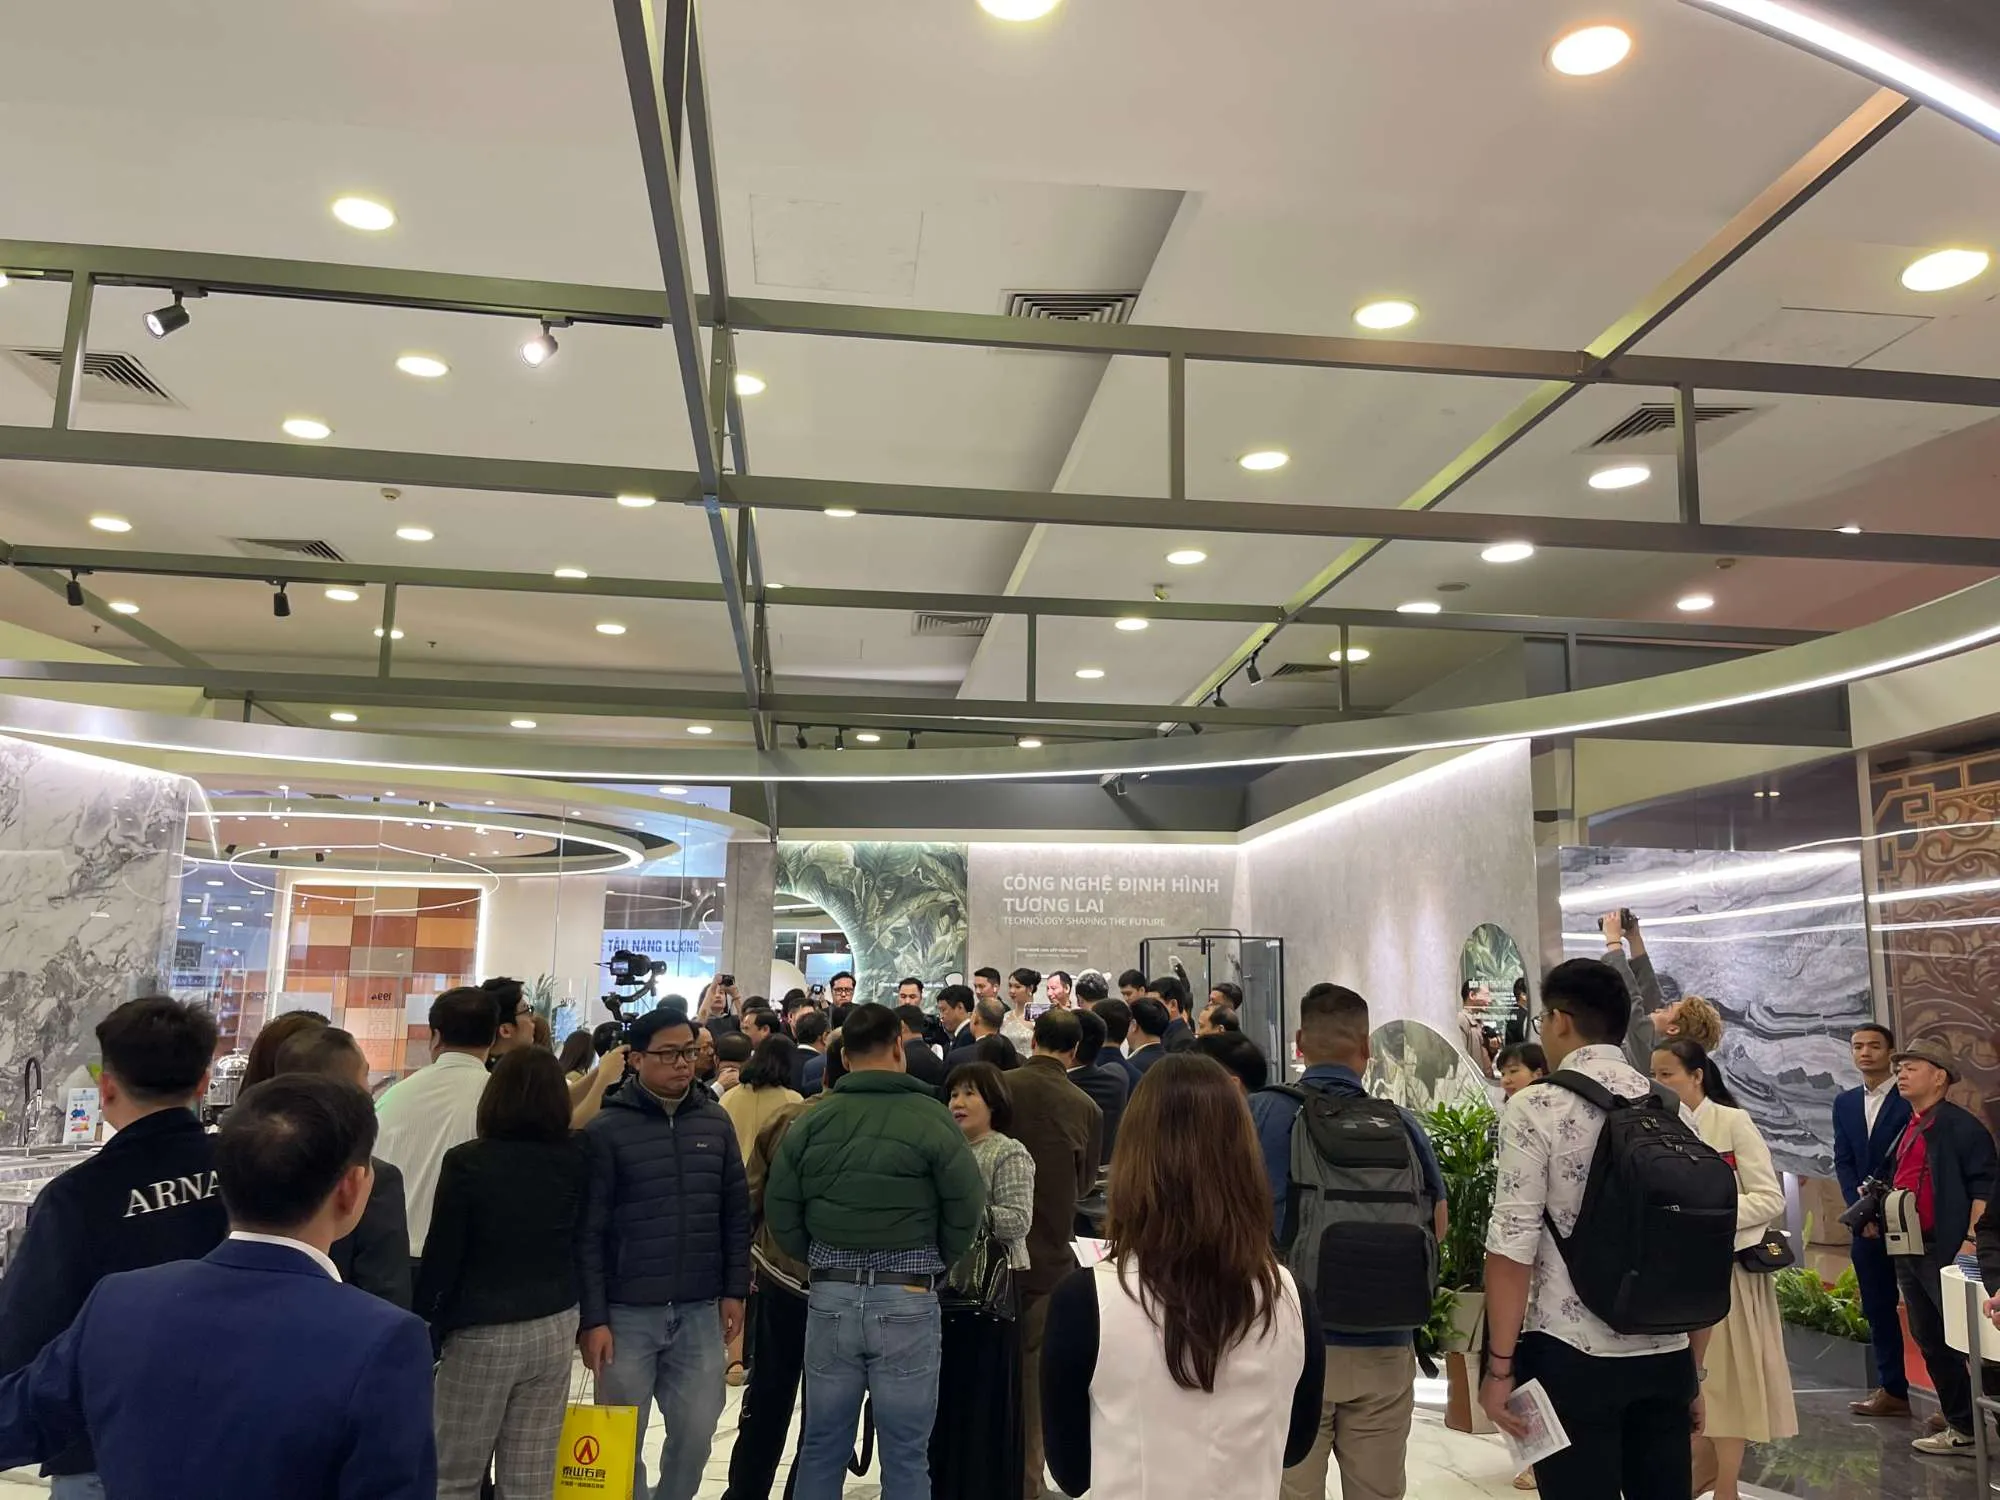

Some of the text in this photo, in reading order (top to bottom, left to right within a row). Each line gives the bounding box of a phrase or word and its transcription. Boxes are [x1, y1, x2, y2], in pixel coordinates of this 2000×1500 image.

[1003, 874, 1220, 895] CÔNG NGHỆ ĐỊNH HÌNH
[1003, 896, 1104, 913] TƯƠNG LAI
[1003, 917, 1166, 927] TECHNOLOGY SHAPING THE FUTURE
